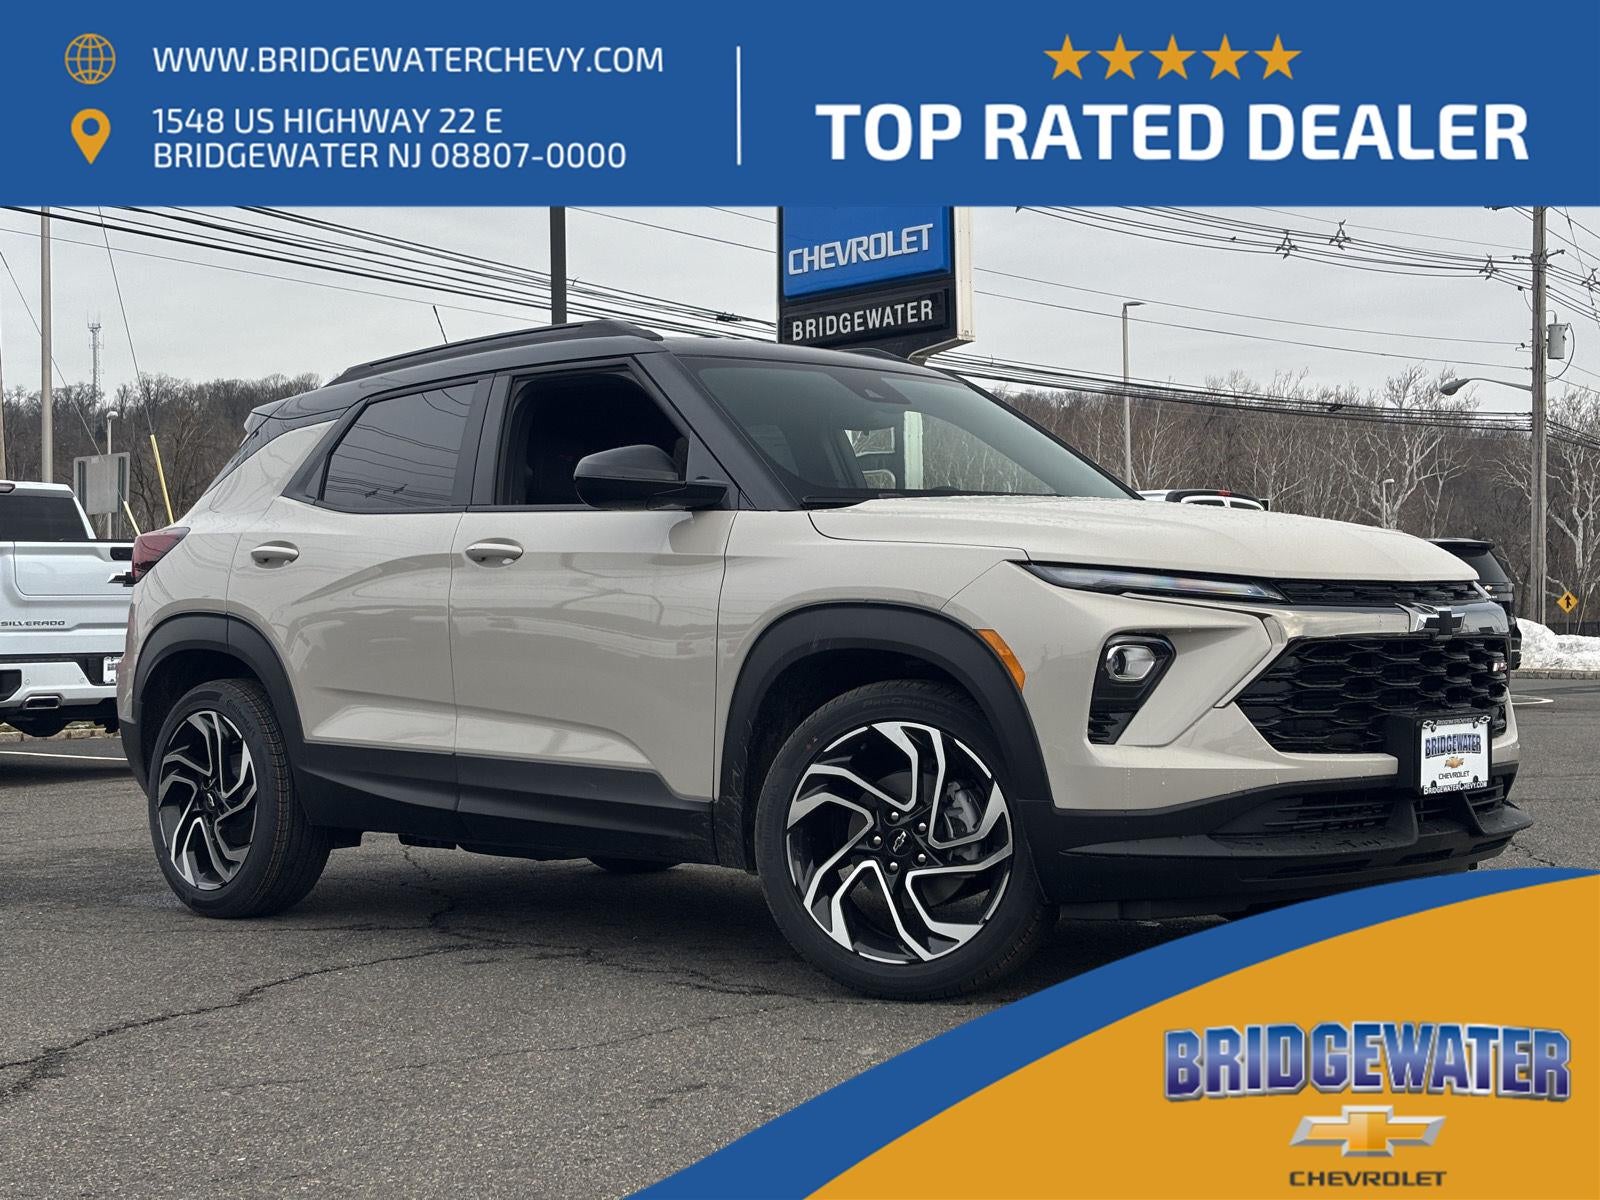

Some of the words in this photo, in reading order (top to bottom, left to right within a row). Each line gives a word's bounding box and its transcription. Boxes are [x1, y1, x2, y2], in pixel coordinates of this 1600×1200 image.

[788, 223, 934, 276] CHEVROLET
[792, 299, 934, 342] BRIDGEWATER
[1425, 733, 1481, 759] BRIDGEWATER
[1438, 770, 1470, 780] CHEVROLET
